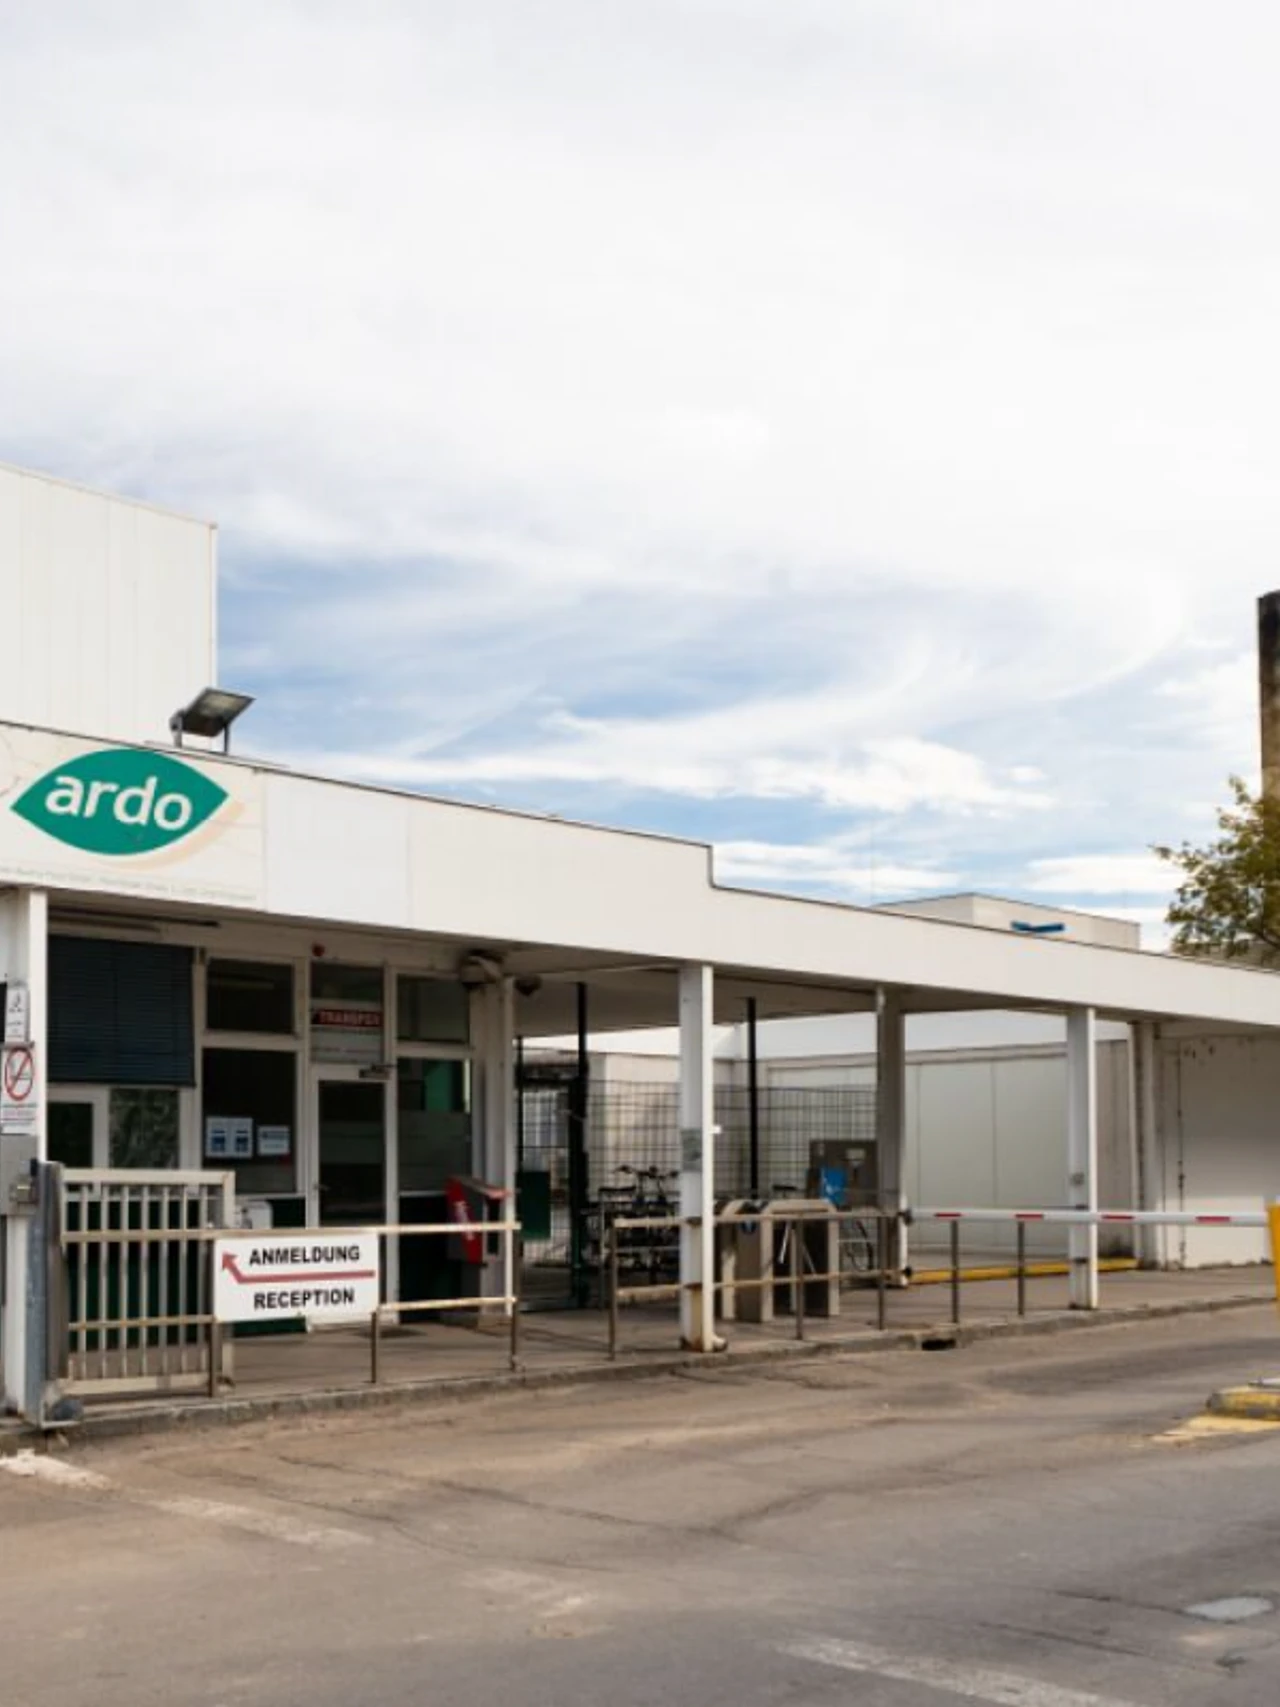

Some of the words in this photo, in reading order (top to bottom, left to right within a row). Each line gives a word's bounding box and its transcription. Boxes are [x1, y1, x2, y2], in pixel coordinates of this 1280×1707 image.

[45, 775, 192, 831] ardo
[249, 1246, 360, 1266] ANMELDUNG
[254, 1288, 355, 1311] RECEPTION
